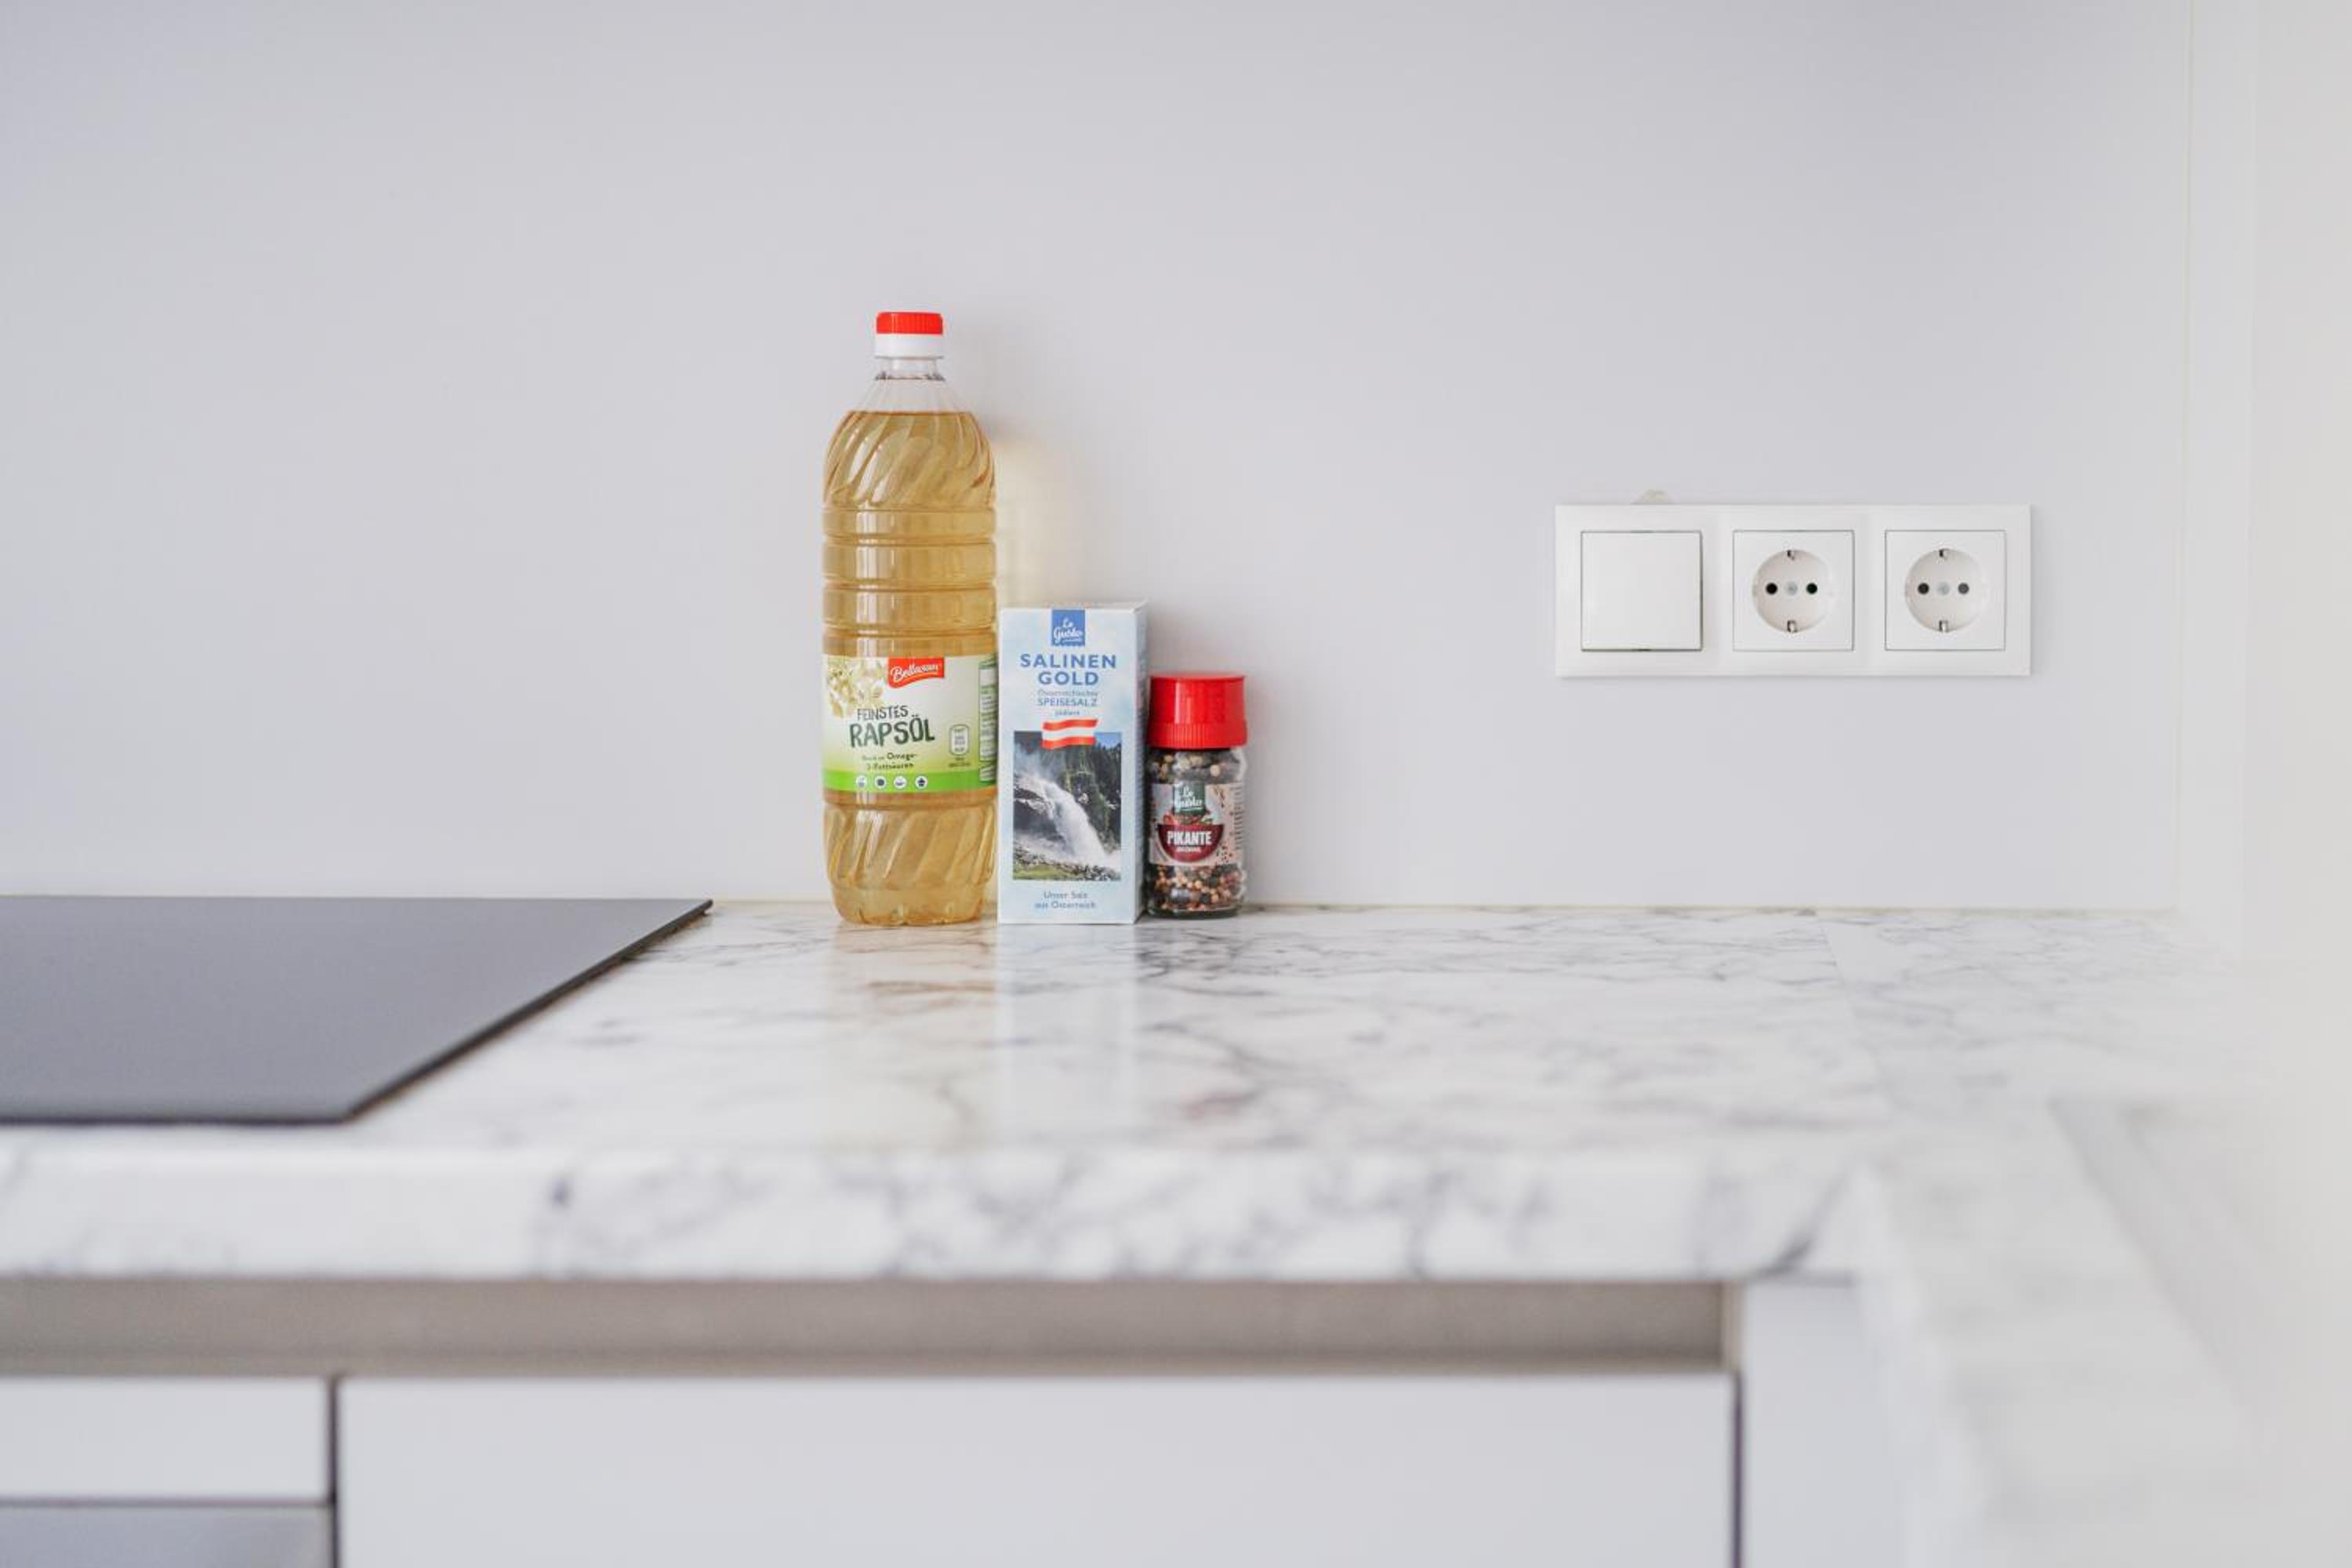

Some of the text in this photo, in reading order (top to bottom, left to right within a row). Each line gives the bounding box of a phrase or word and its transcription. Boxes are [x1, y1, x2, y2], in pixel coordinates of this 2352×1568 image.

[1020, 653, 1116, 668] SALINEN
[1038, 672, 1099, 685] GOLD
[1037, 698, 1098, 706] SPEISESALZ
[857, 706, 909, 720] FEINSTES
[850, 714, 935, 747] RAPSÖL
[1167, 830, 1212, 846] PIKANTE
